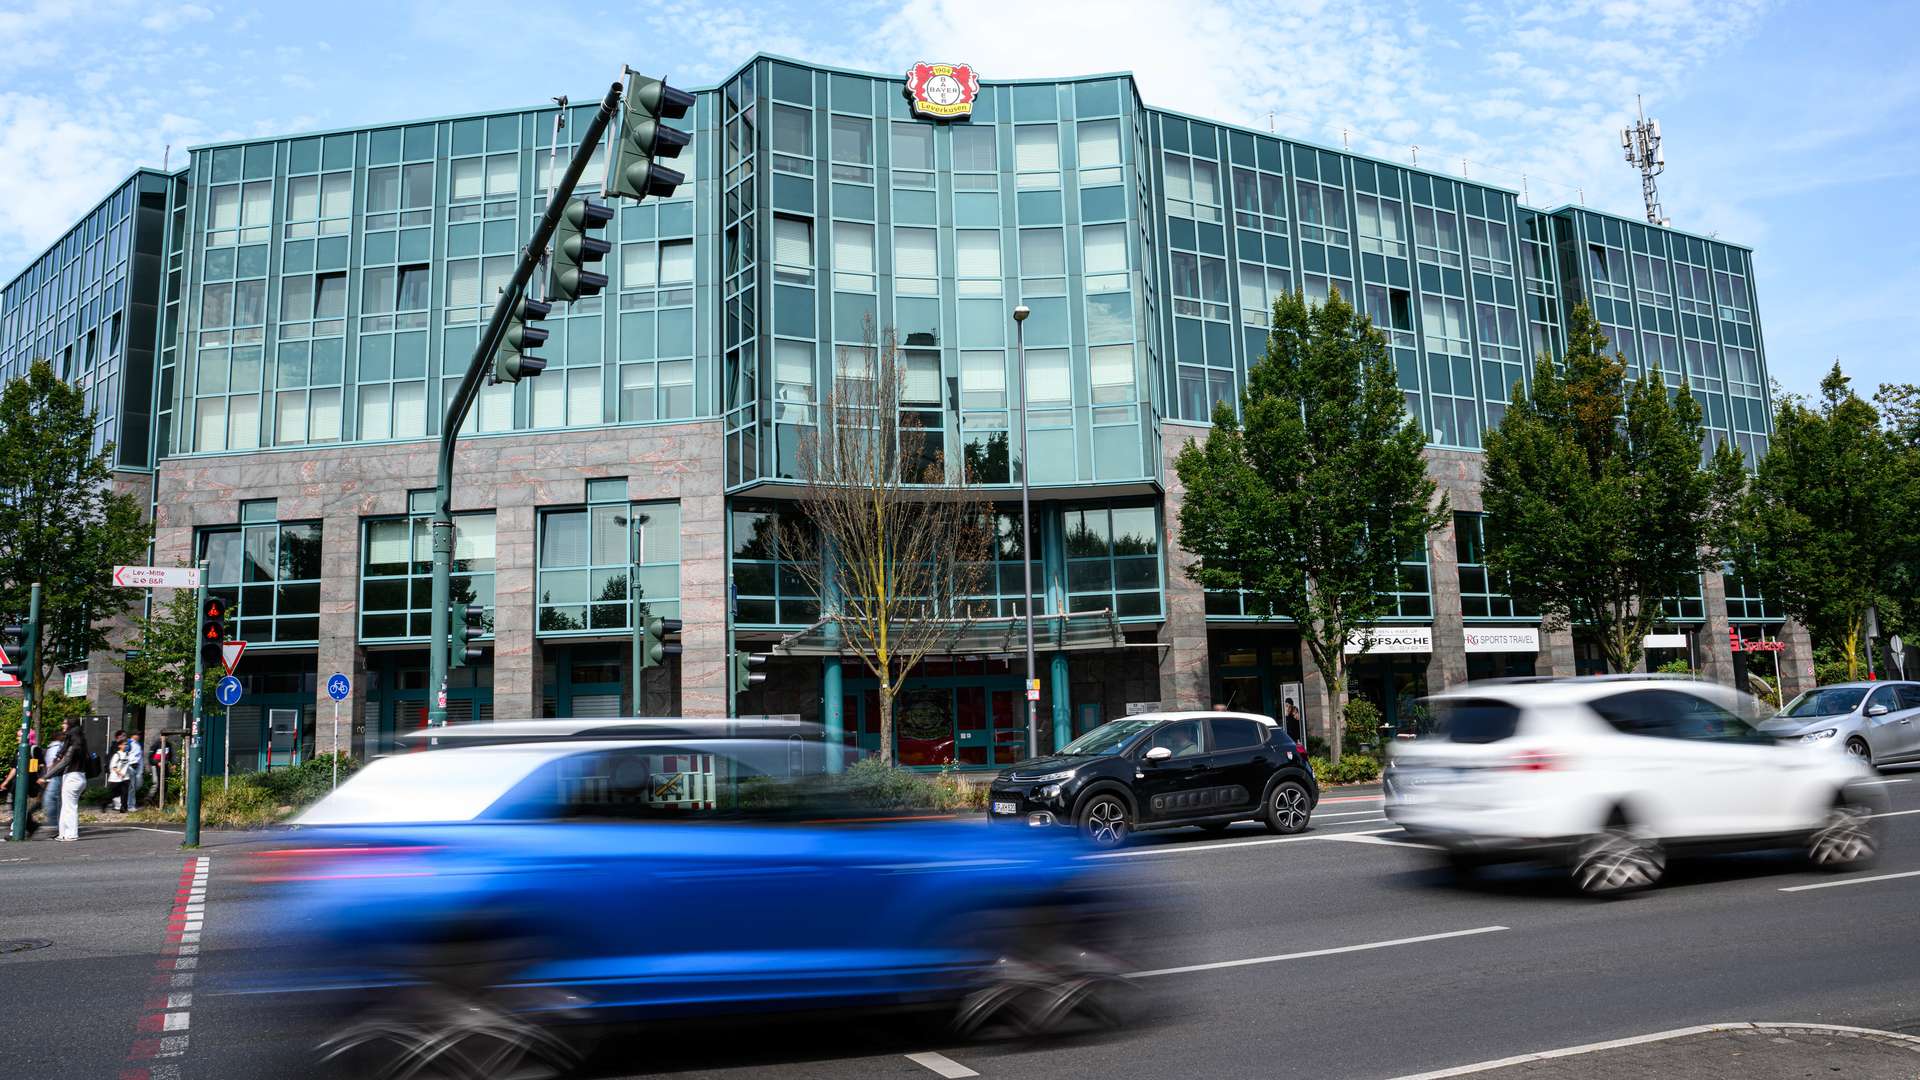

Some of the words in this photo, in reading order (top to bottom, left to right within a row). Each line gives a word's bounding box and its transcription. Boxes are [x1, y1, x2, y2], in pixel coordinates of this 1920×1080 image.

[921, 103, 967, 113] Leverkusen
[1480, 635, 1508, 644] SPORTS
[1509, 635, 1534, 644] TRAVEL
